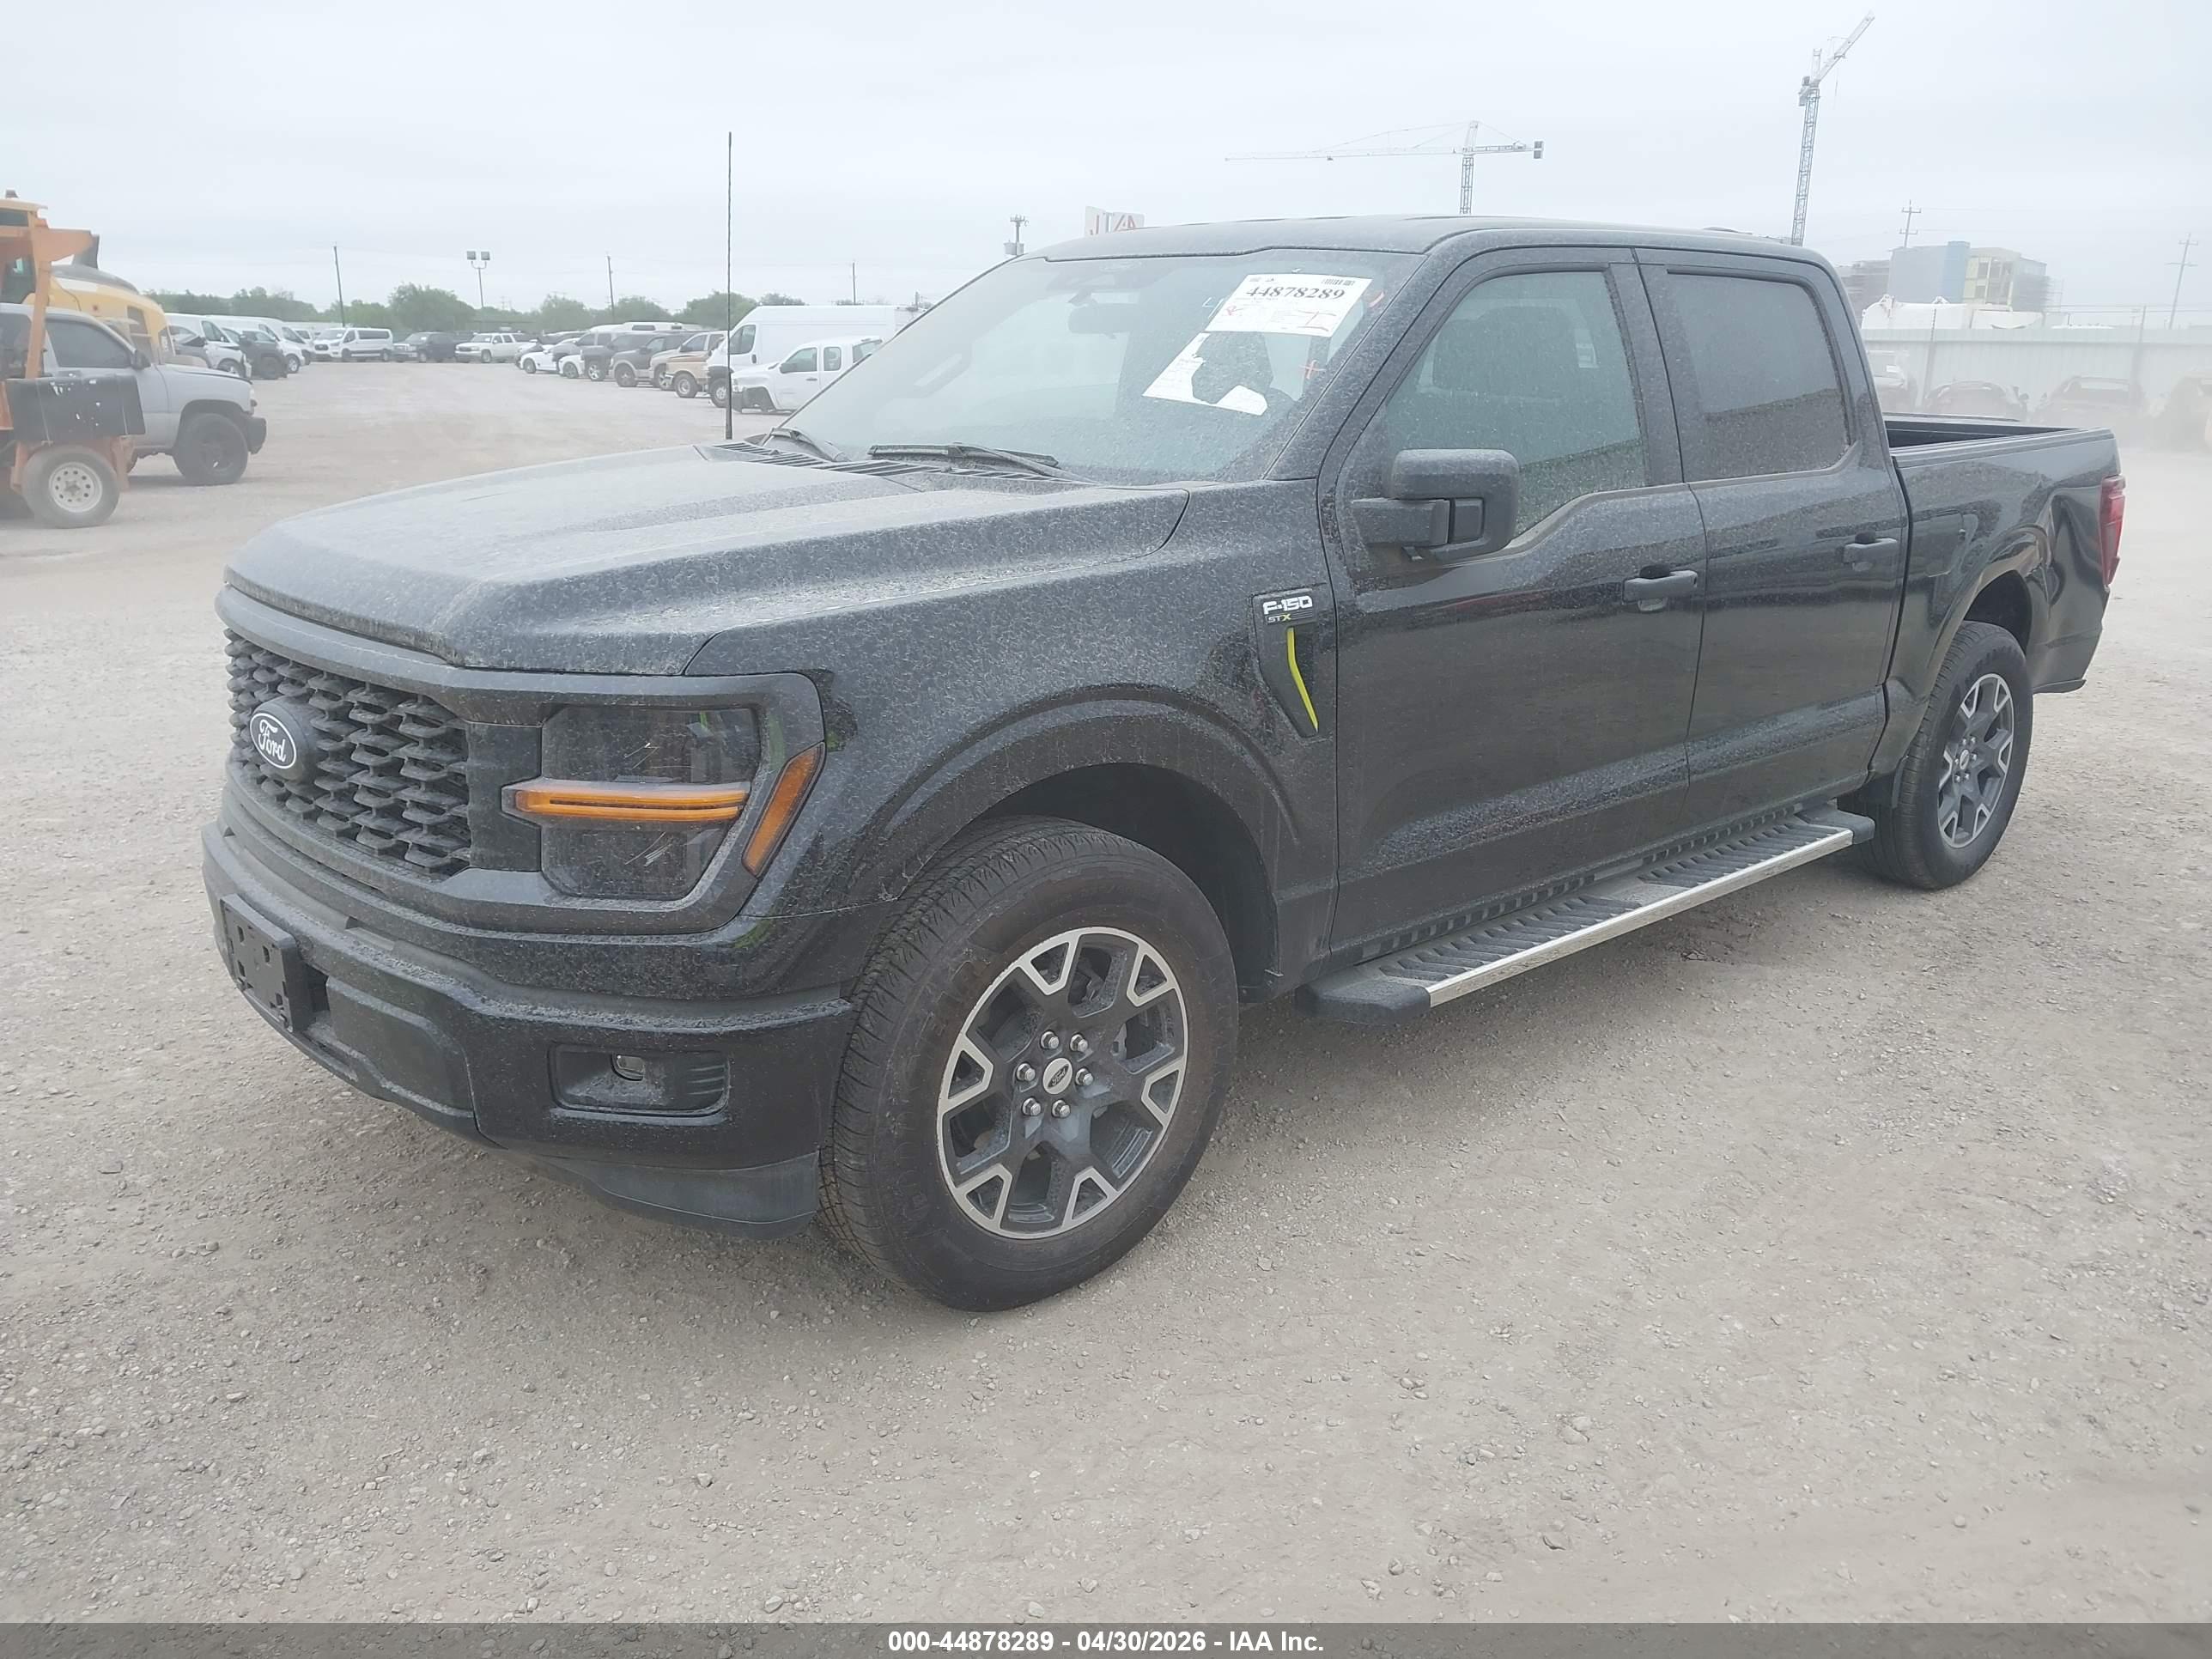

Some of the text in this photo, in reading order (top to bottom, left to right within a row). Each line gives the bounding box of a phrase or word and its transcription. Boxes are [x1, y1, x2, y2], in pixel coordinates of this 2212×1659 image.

[1245, 285, 1346, 301] 44878289
[1262, 595, 1313, 615] F-150
[1268, 614, 1292, 623] STX
[258, 719, 287, 763] Ford
[1051, 1067, 1066, 1086] Ford
